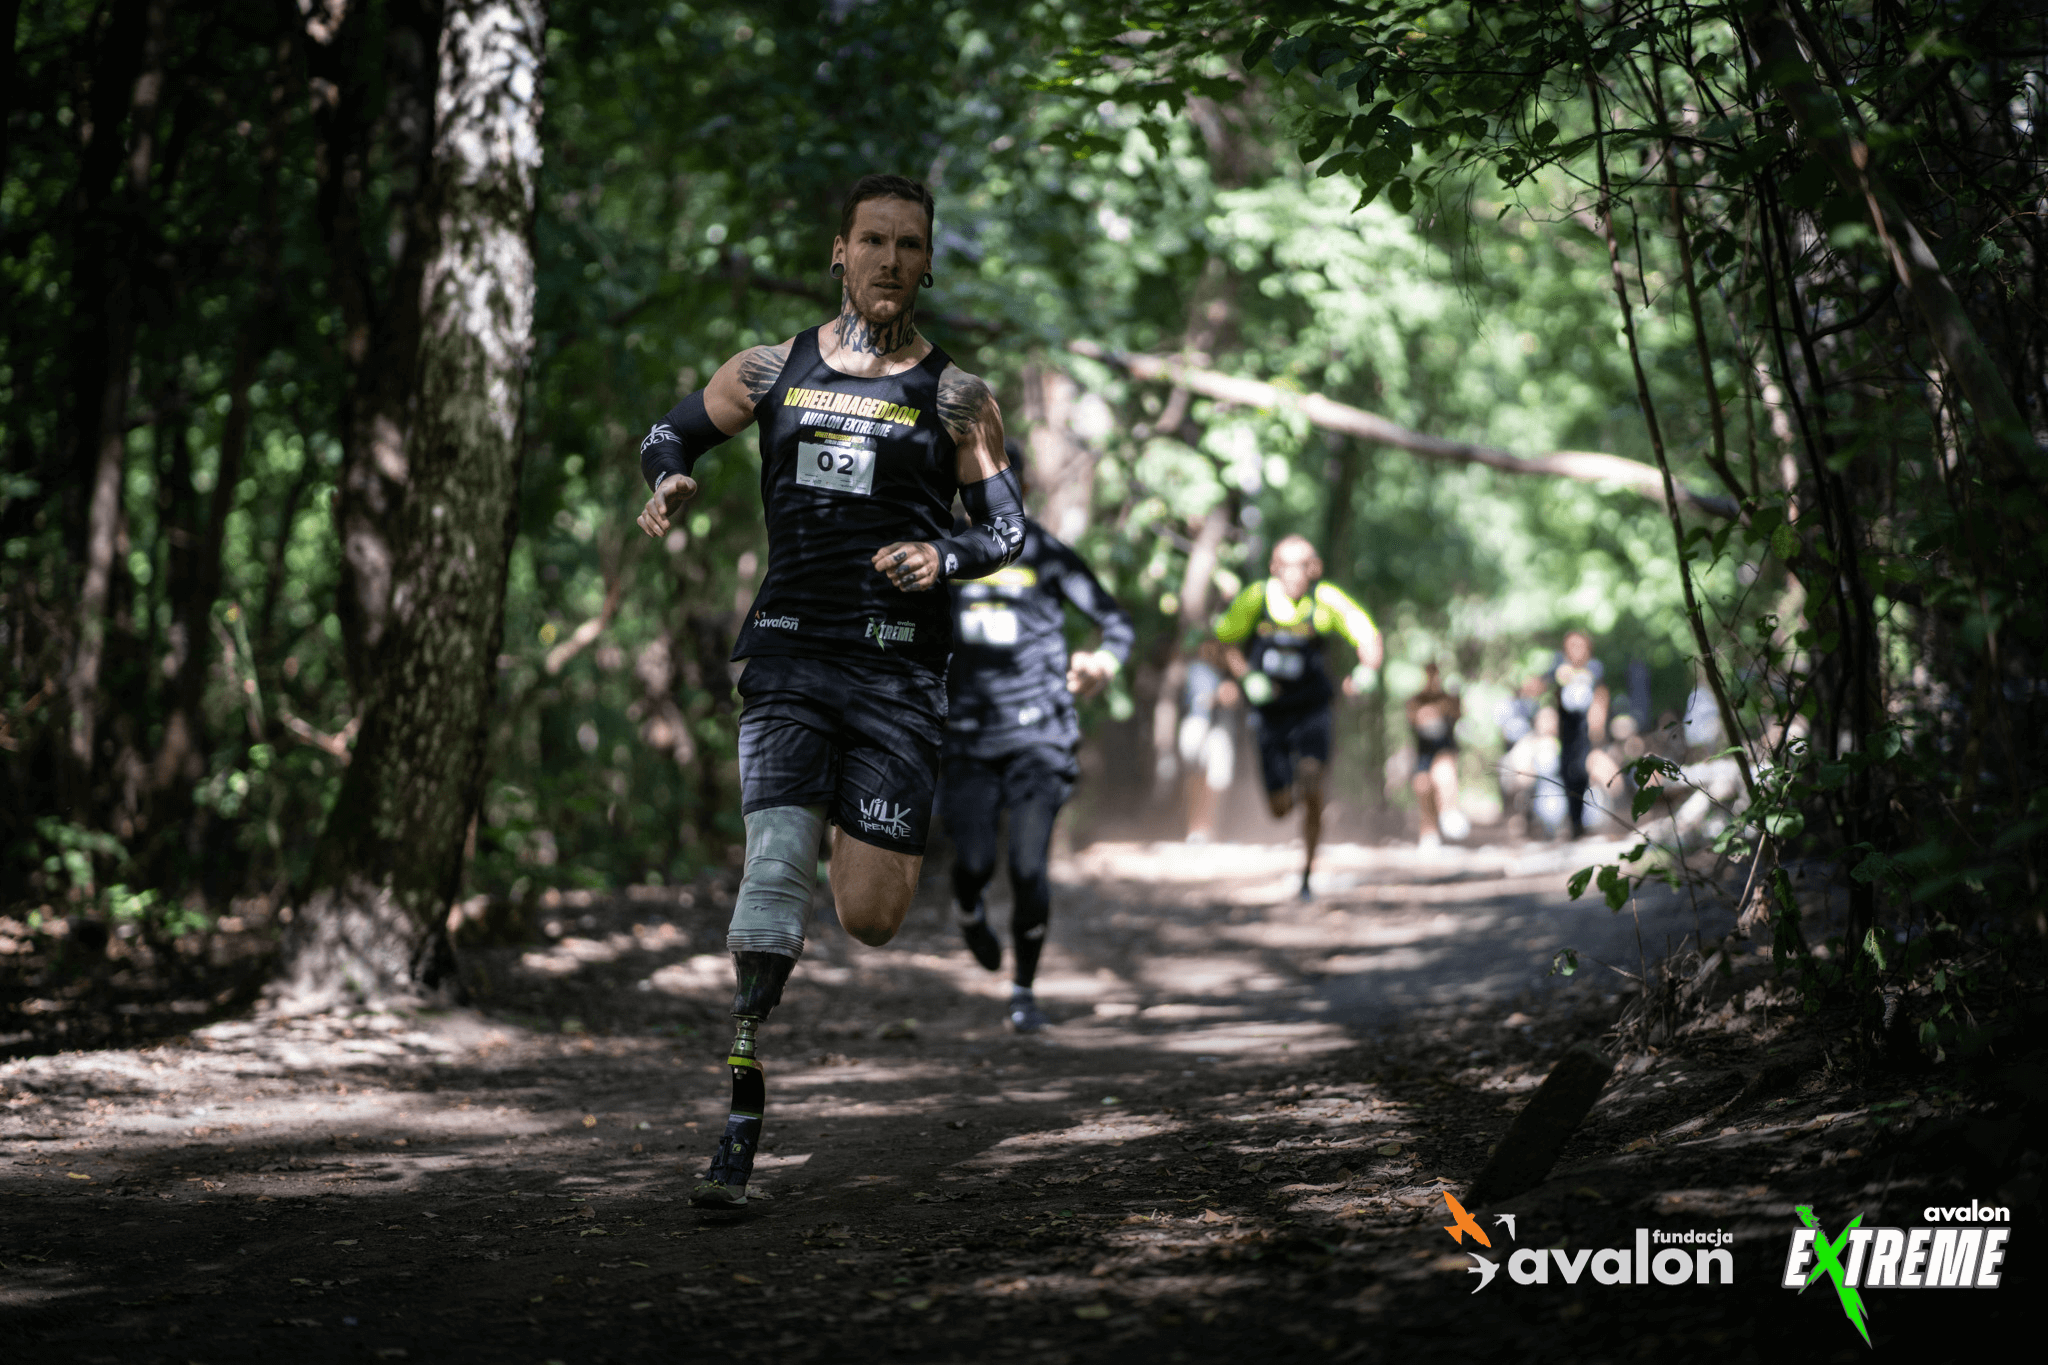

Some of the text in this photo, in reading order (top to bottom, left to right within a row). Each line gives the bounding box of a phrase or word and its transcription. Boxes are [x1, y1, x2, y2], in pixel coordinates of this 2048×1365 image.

[783, 387, 921, 427] WHEELMAGEDDON
[800, 411, 844, 430] AVALON
[842, 417, 892, 437] EXTREME
[817, 451, 854, 475] 02
[760, 616, 799, 630] avalon
[858, 820, 911, 839] TRENUJE
